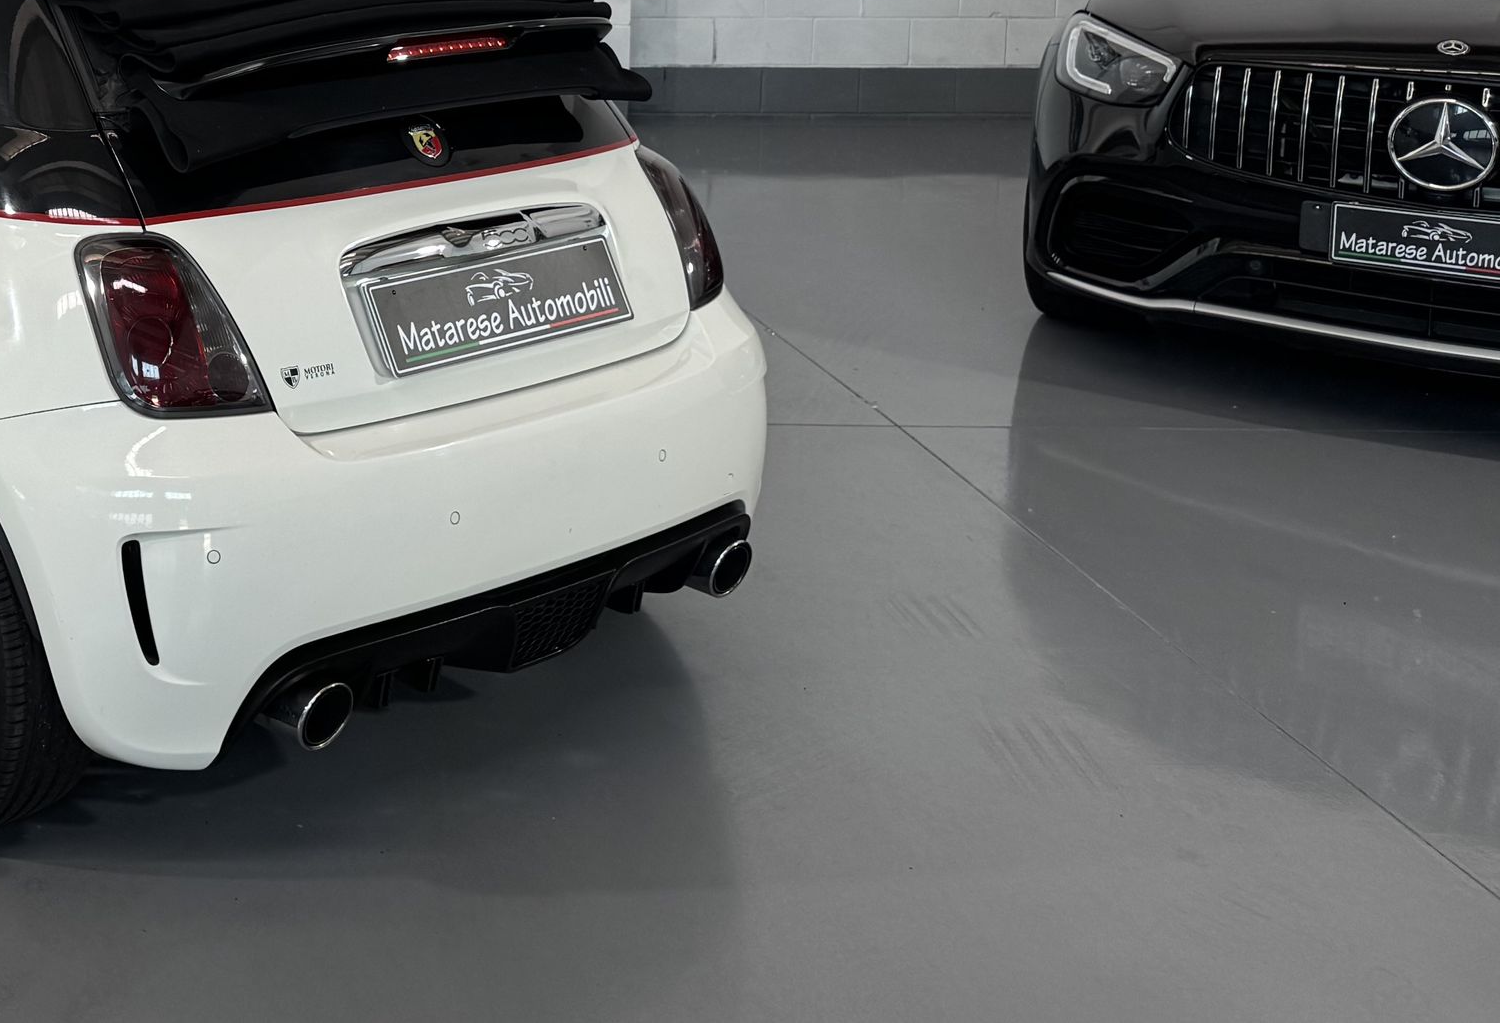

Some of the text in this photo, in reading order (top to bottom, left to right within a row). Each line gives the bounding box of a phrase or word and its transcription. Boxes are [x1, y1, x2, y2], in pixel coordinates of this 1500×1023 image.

[481, 227, 529, 248] 500
[1339, 231, 1427, 260] Matarese
[396, 277, 617, 355] Matarese Automobili
[304, 363, 334, 374] MOTORI
